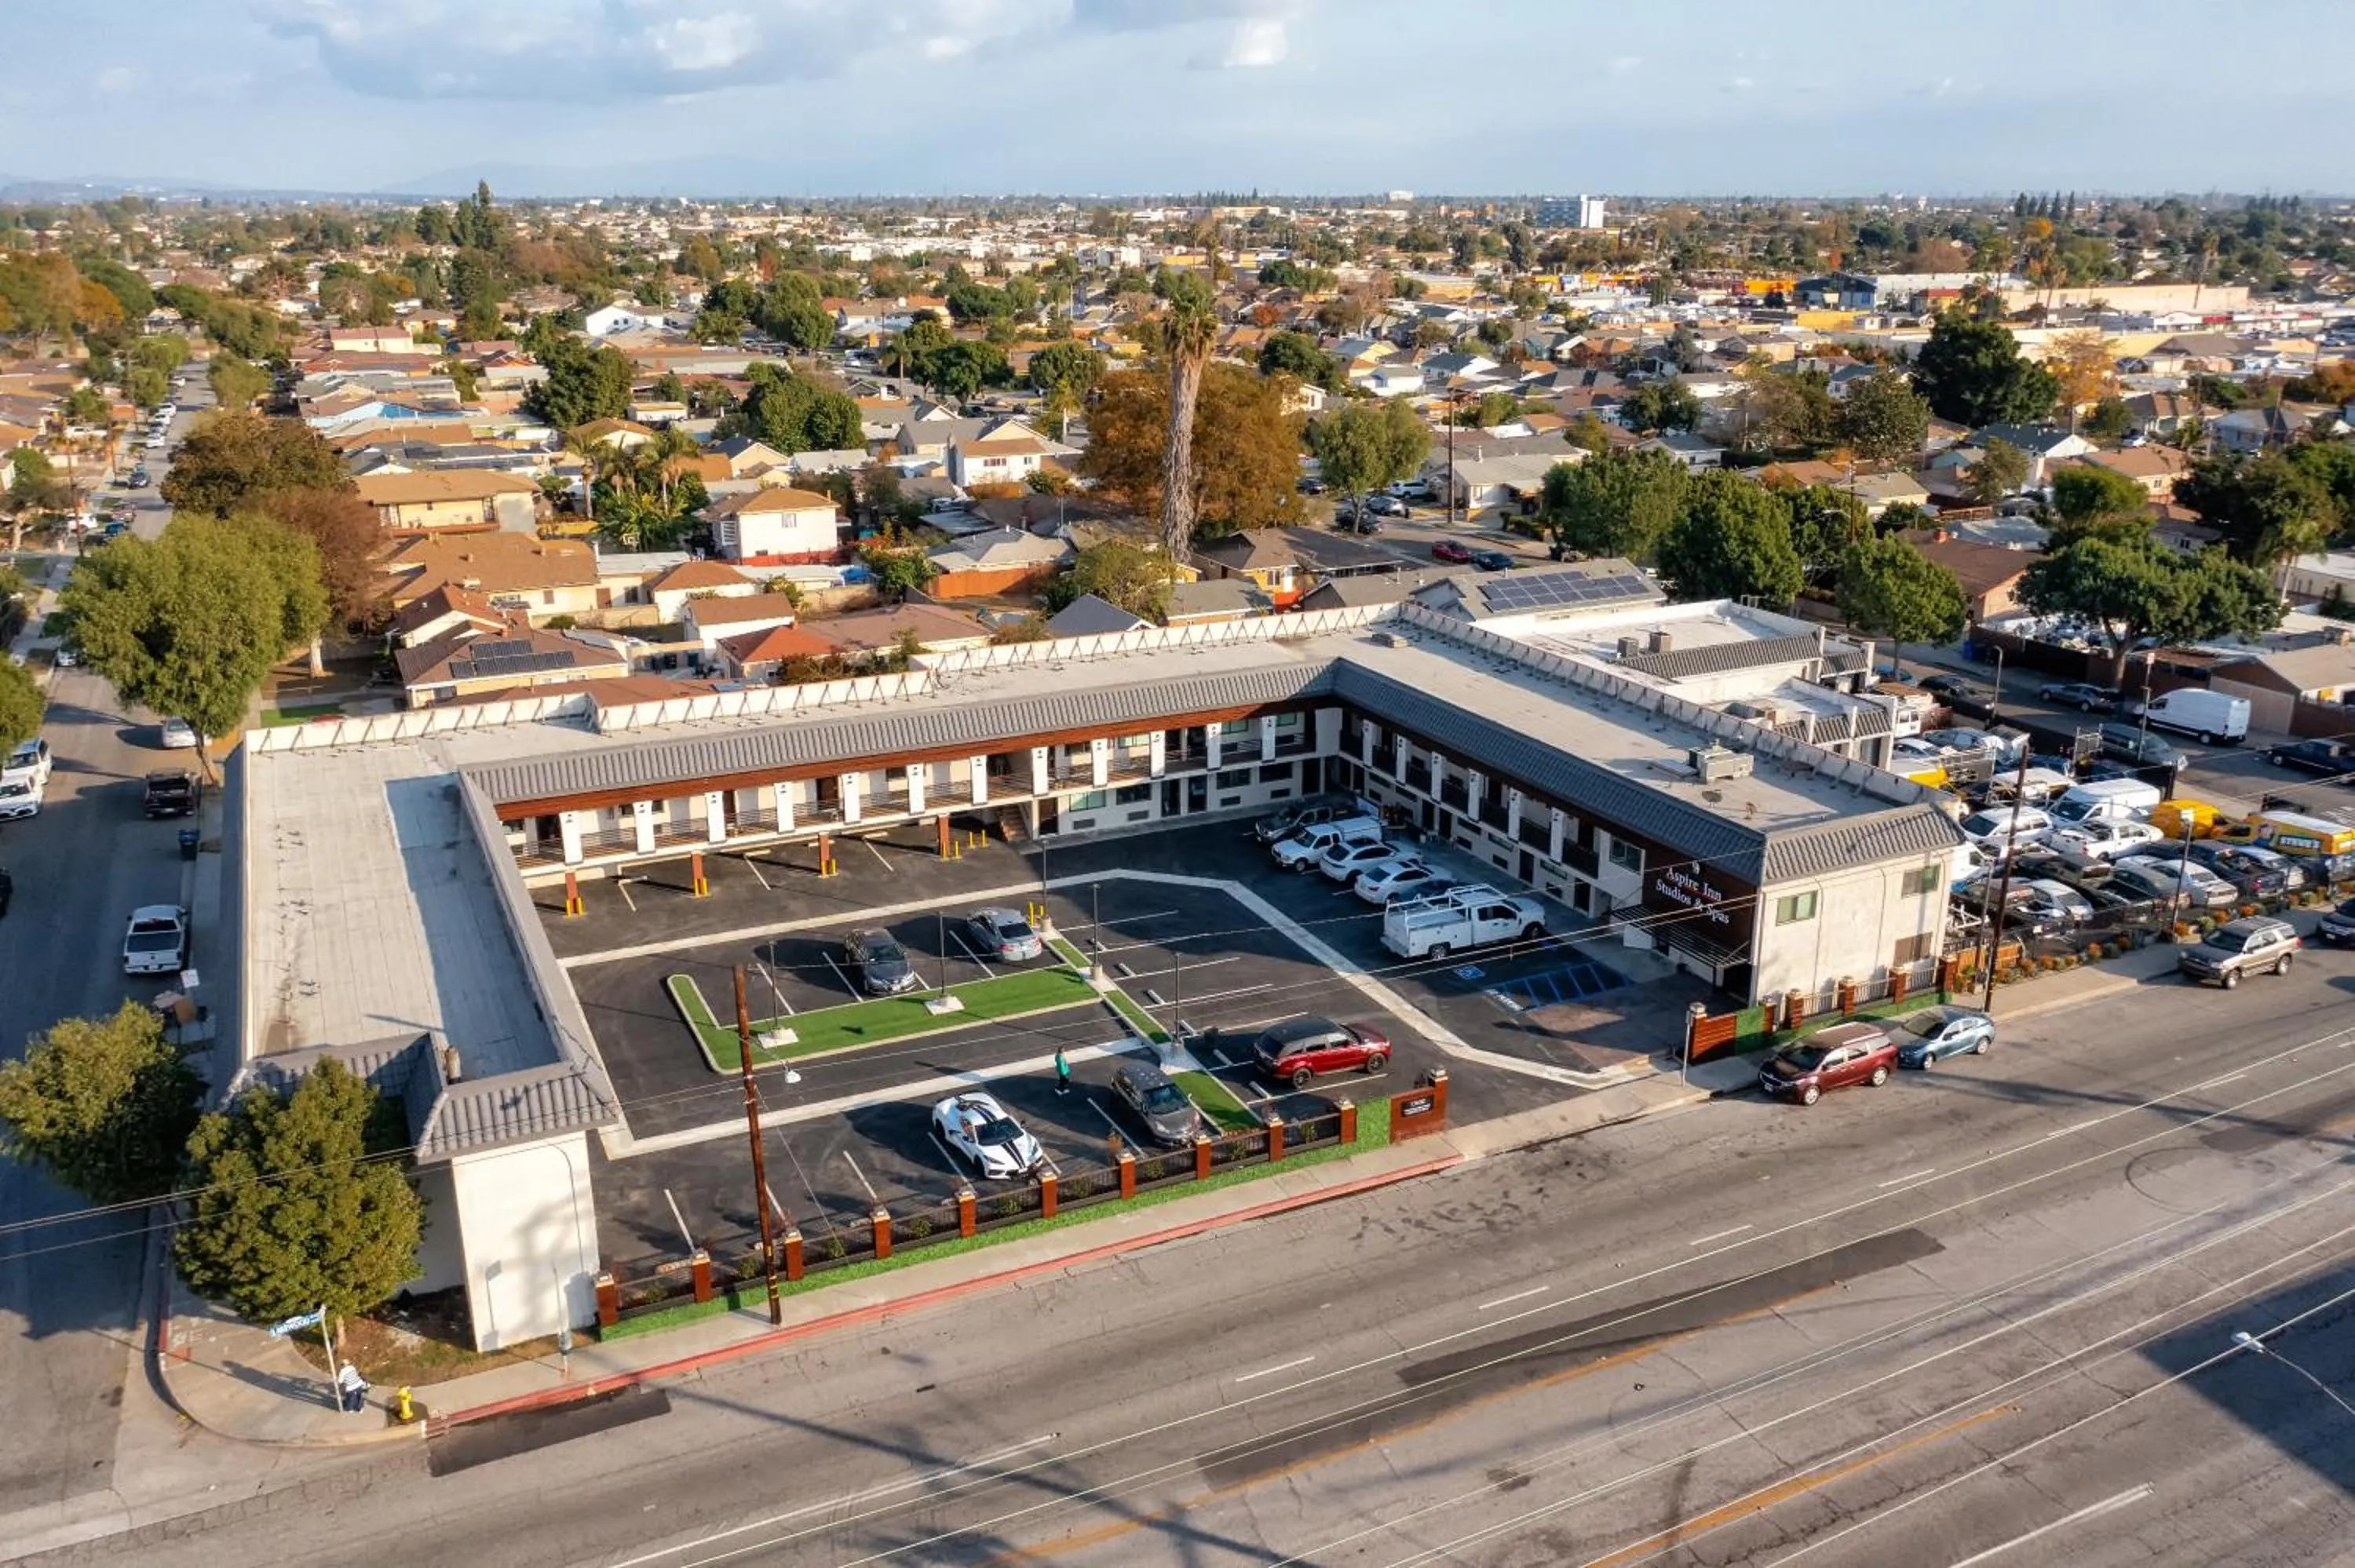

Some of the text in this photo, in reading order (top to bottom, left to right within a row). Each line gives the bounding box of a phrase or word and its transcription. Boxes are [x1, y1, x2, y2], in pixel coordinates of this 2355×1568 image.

[1656, 878, 1729, 924] Studios & Spas
[1667, 867, 1722, 902] Aspire Inn
